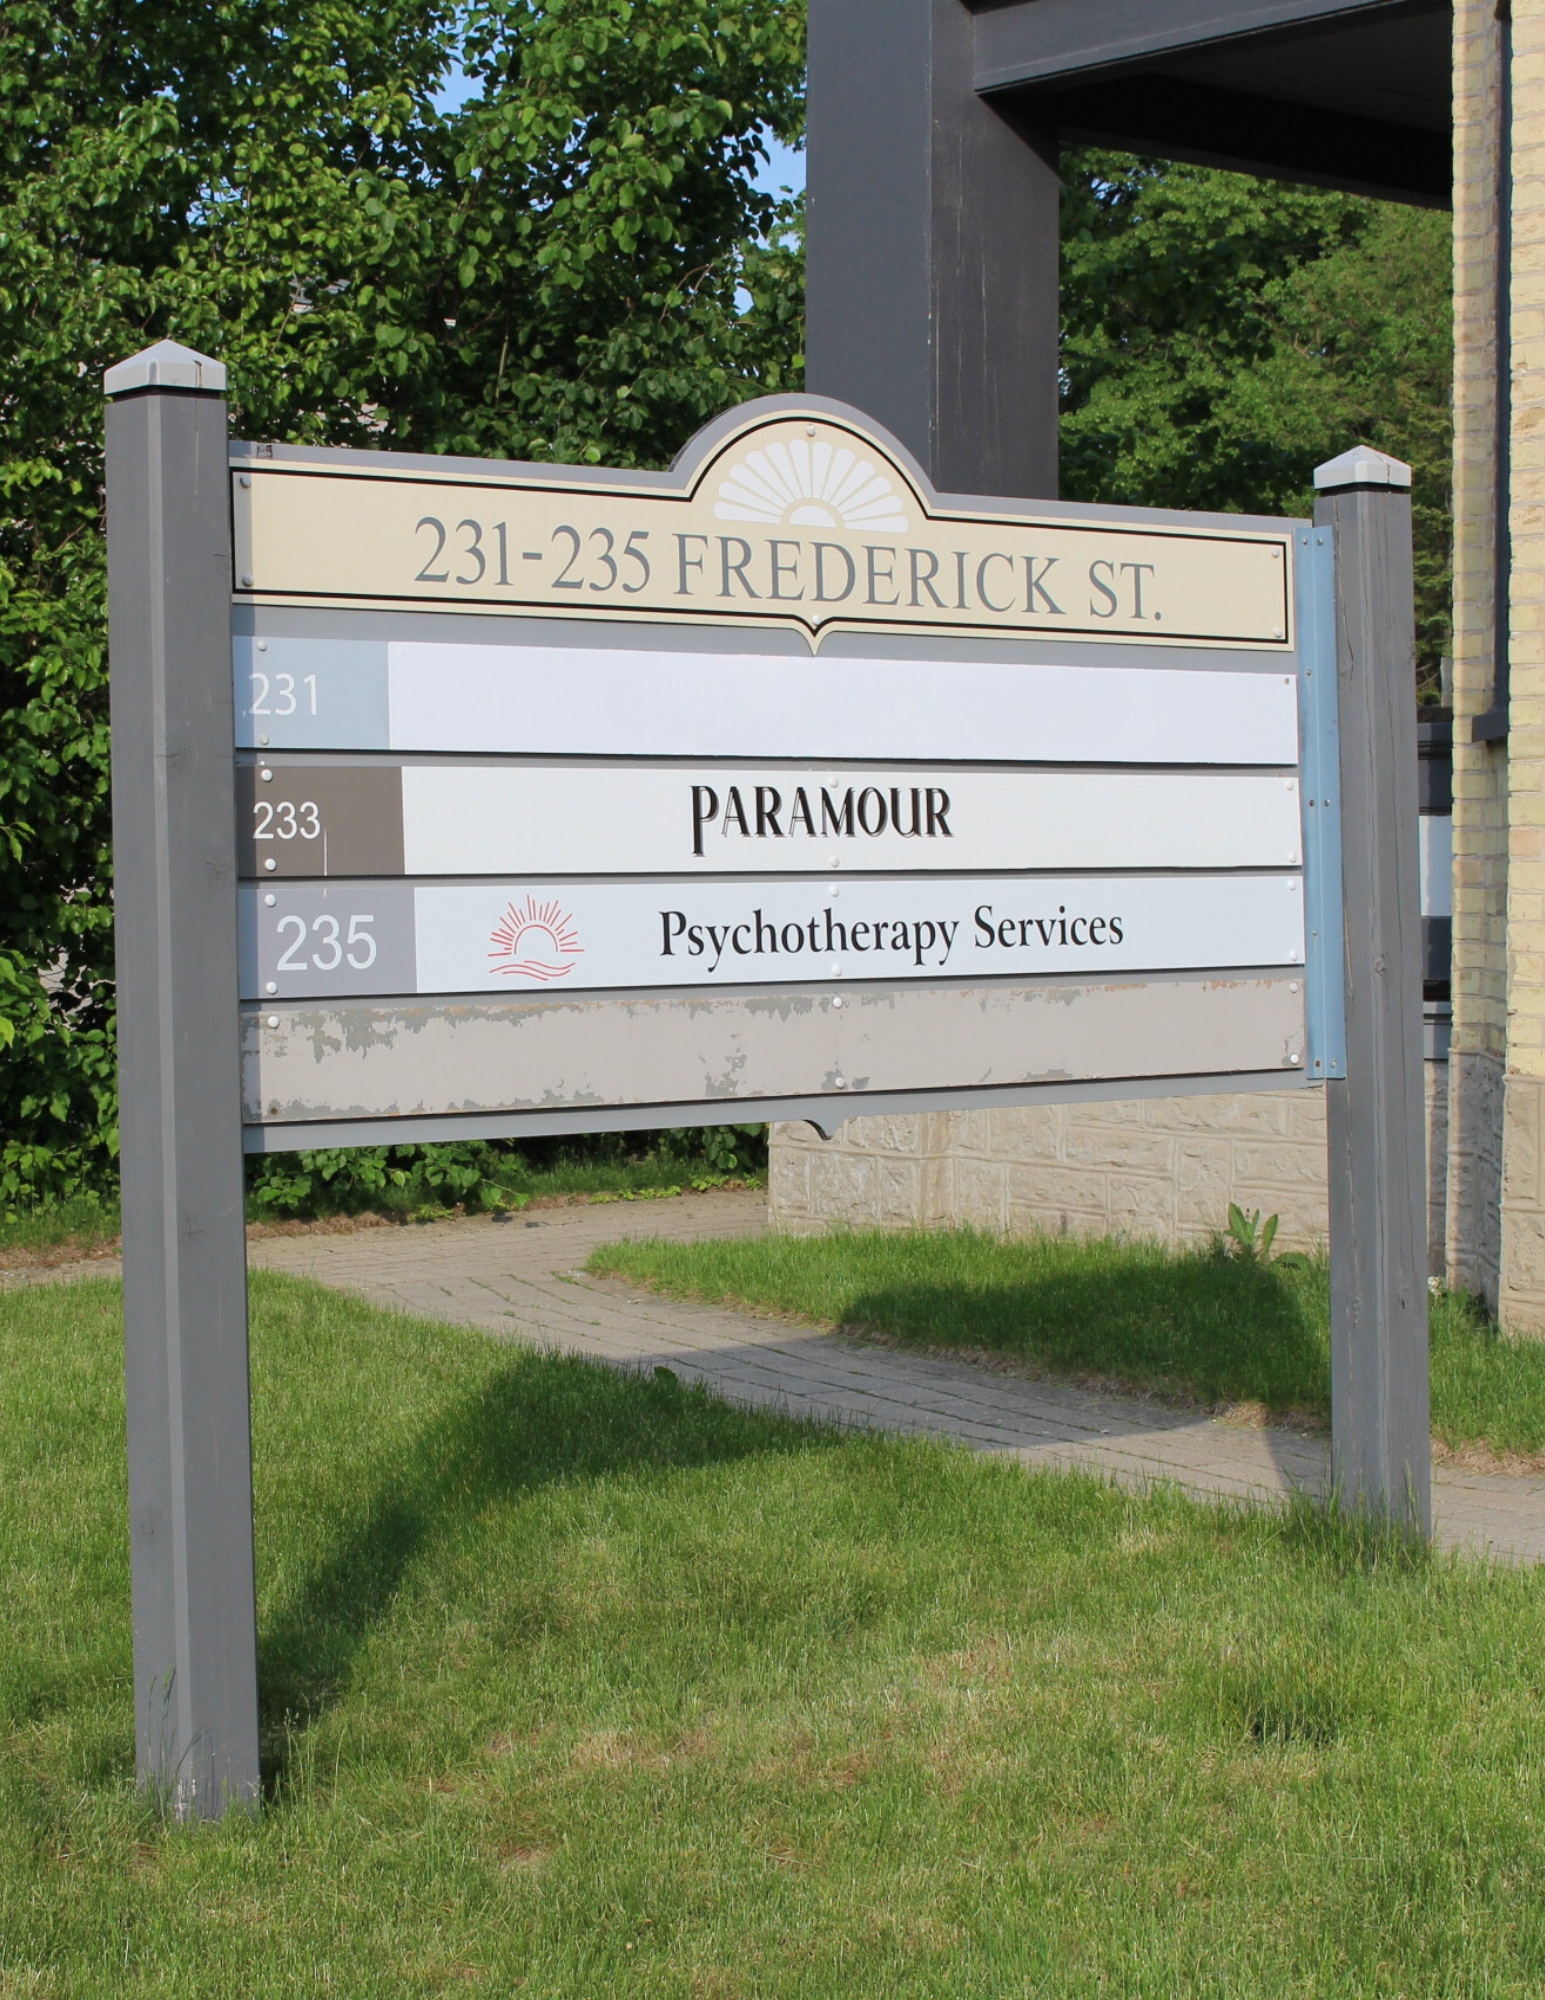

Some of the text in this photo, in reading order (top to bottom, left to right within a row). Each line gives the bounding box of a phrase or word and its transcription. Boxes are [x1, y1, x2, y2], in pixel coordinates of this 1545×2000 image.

[414, 516, 1163, 622] 231-235 FREDERICK ST.
[248, 672, 318, 716] 231
[252, 801, 321, 840] 233
[690, 784, 955, 858] PARAMOUR
[276, 914, 378, 972] 235
[658, 904, 1125, 973] Psychotherapy Services
